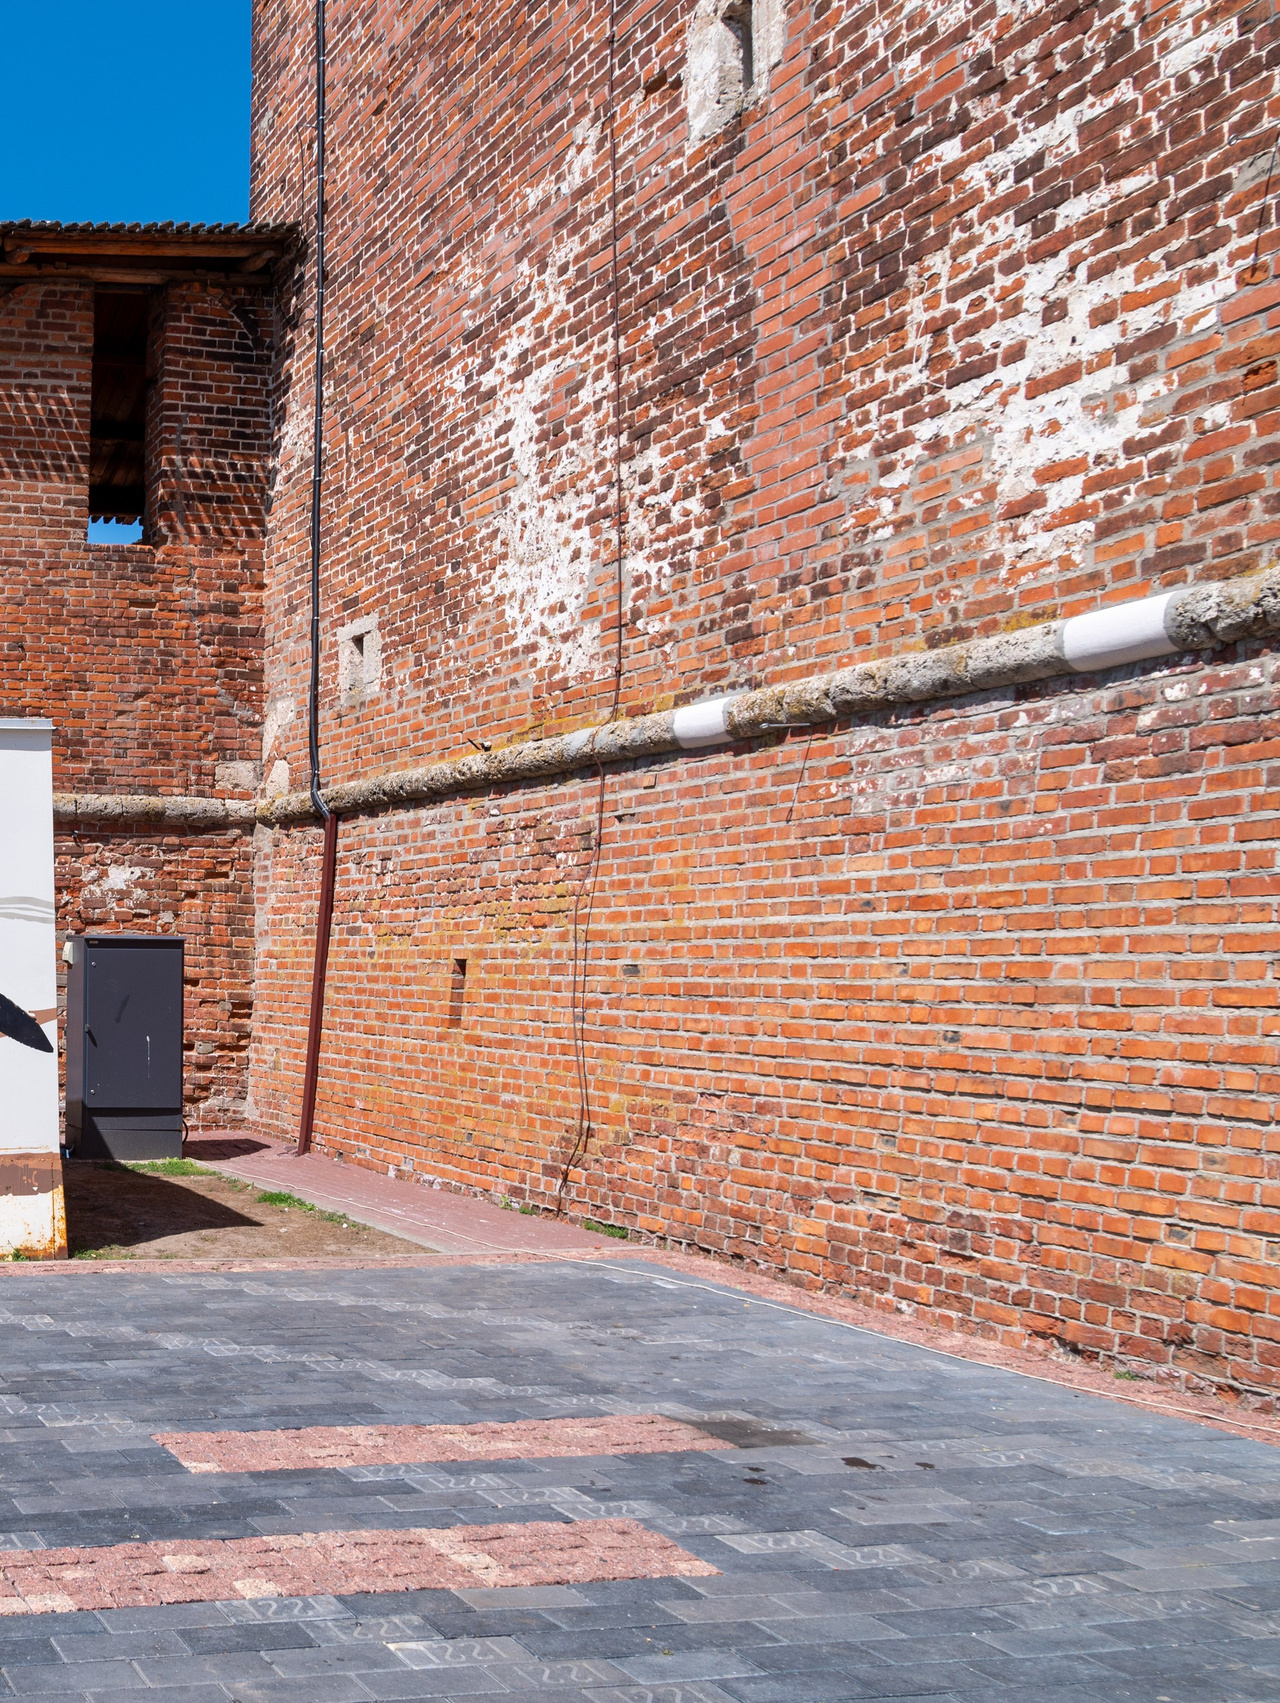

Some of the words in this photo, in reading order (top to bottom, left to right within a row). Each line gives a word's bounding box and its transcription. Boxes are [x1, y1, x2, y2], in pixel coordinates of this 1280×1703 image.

[429, 1474, 497, 1489] 1221
[743, 1532, 822, 1549] 1221
[828, 1547, 912, 1565] 1221
[1023, 1577, 1109, 1597] 1221
[242, 1597, 322, 1619] 1221
[328, 1618, 416, 1640] 1221
[418, 1640, 509, 1664] 1221
[514, 1662, 608, 1688] 1221
